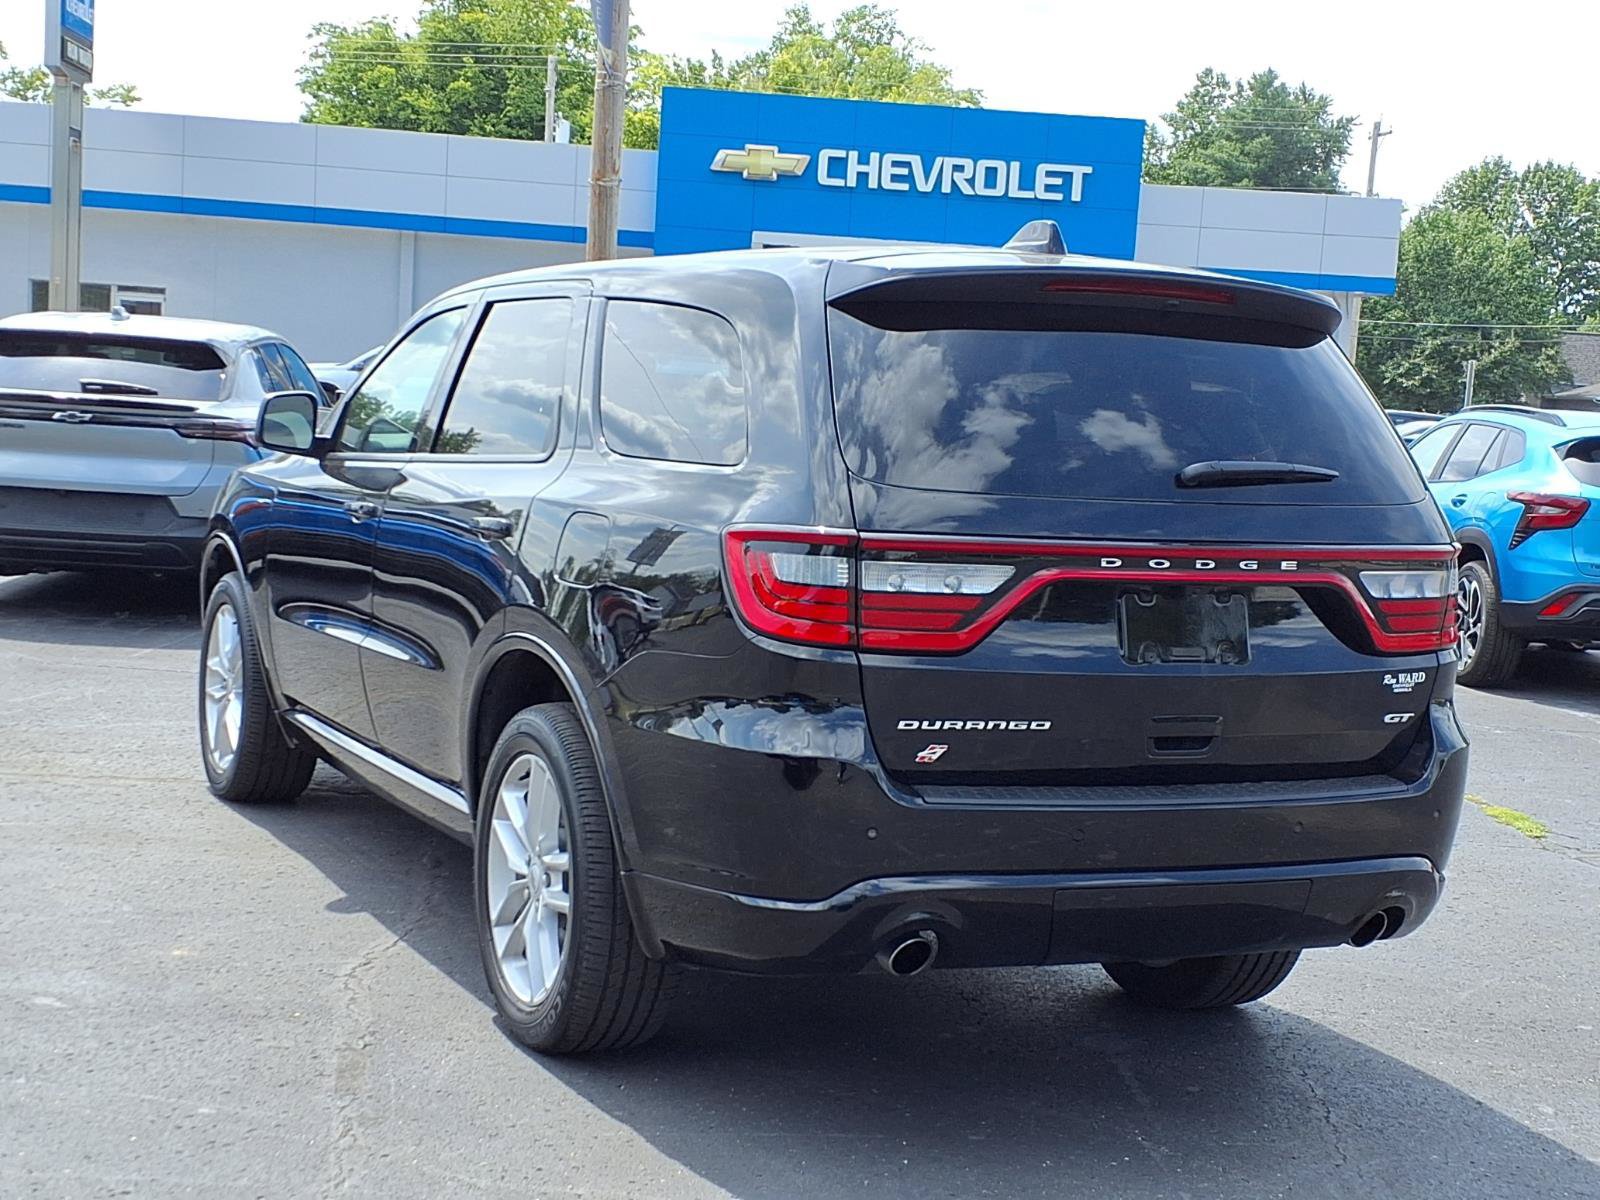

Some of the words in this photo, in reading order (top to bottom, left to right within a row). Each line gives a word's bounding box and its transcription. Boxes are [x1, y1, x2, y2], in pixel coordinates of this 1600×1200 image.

[817, 148, 1093, 202] CHEVROLET
[1100, 557, 1298, 571] DODGE
[1398, 671, 1426, 684] WARD
[1384, 712, 1415, 723] GT
[897, 720, 1052, 730] DURANGO
